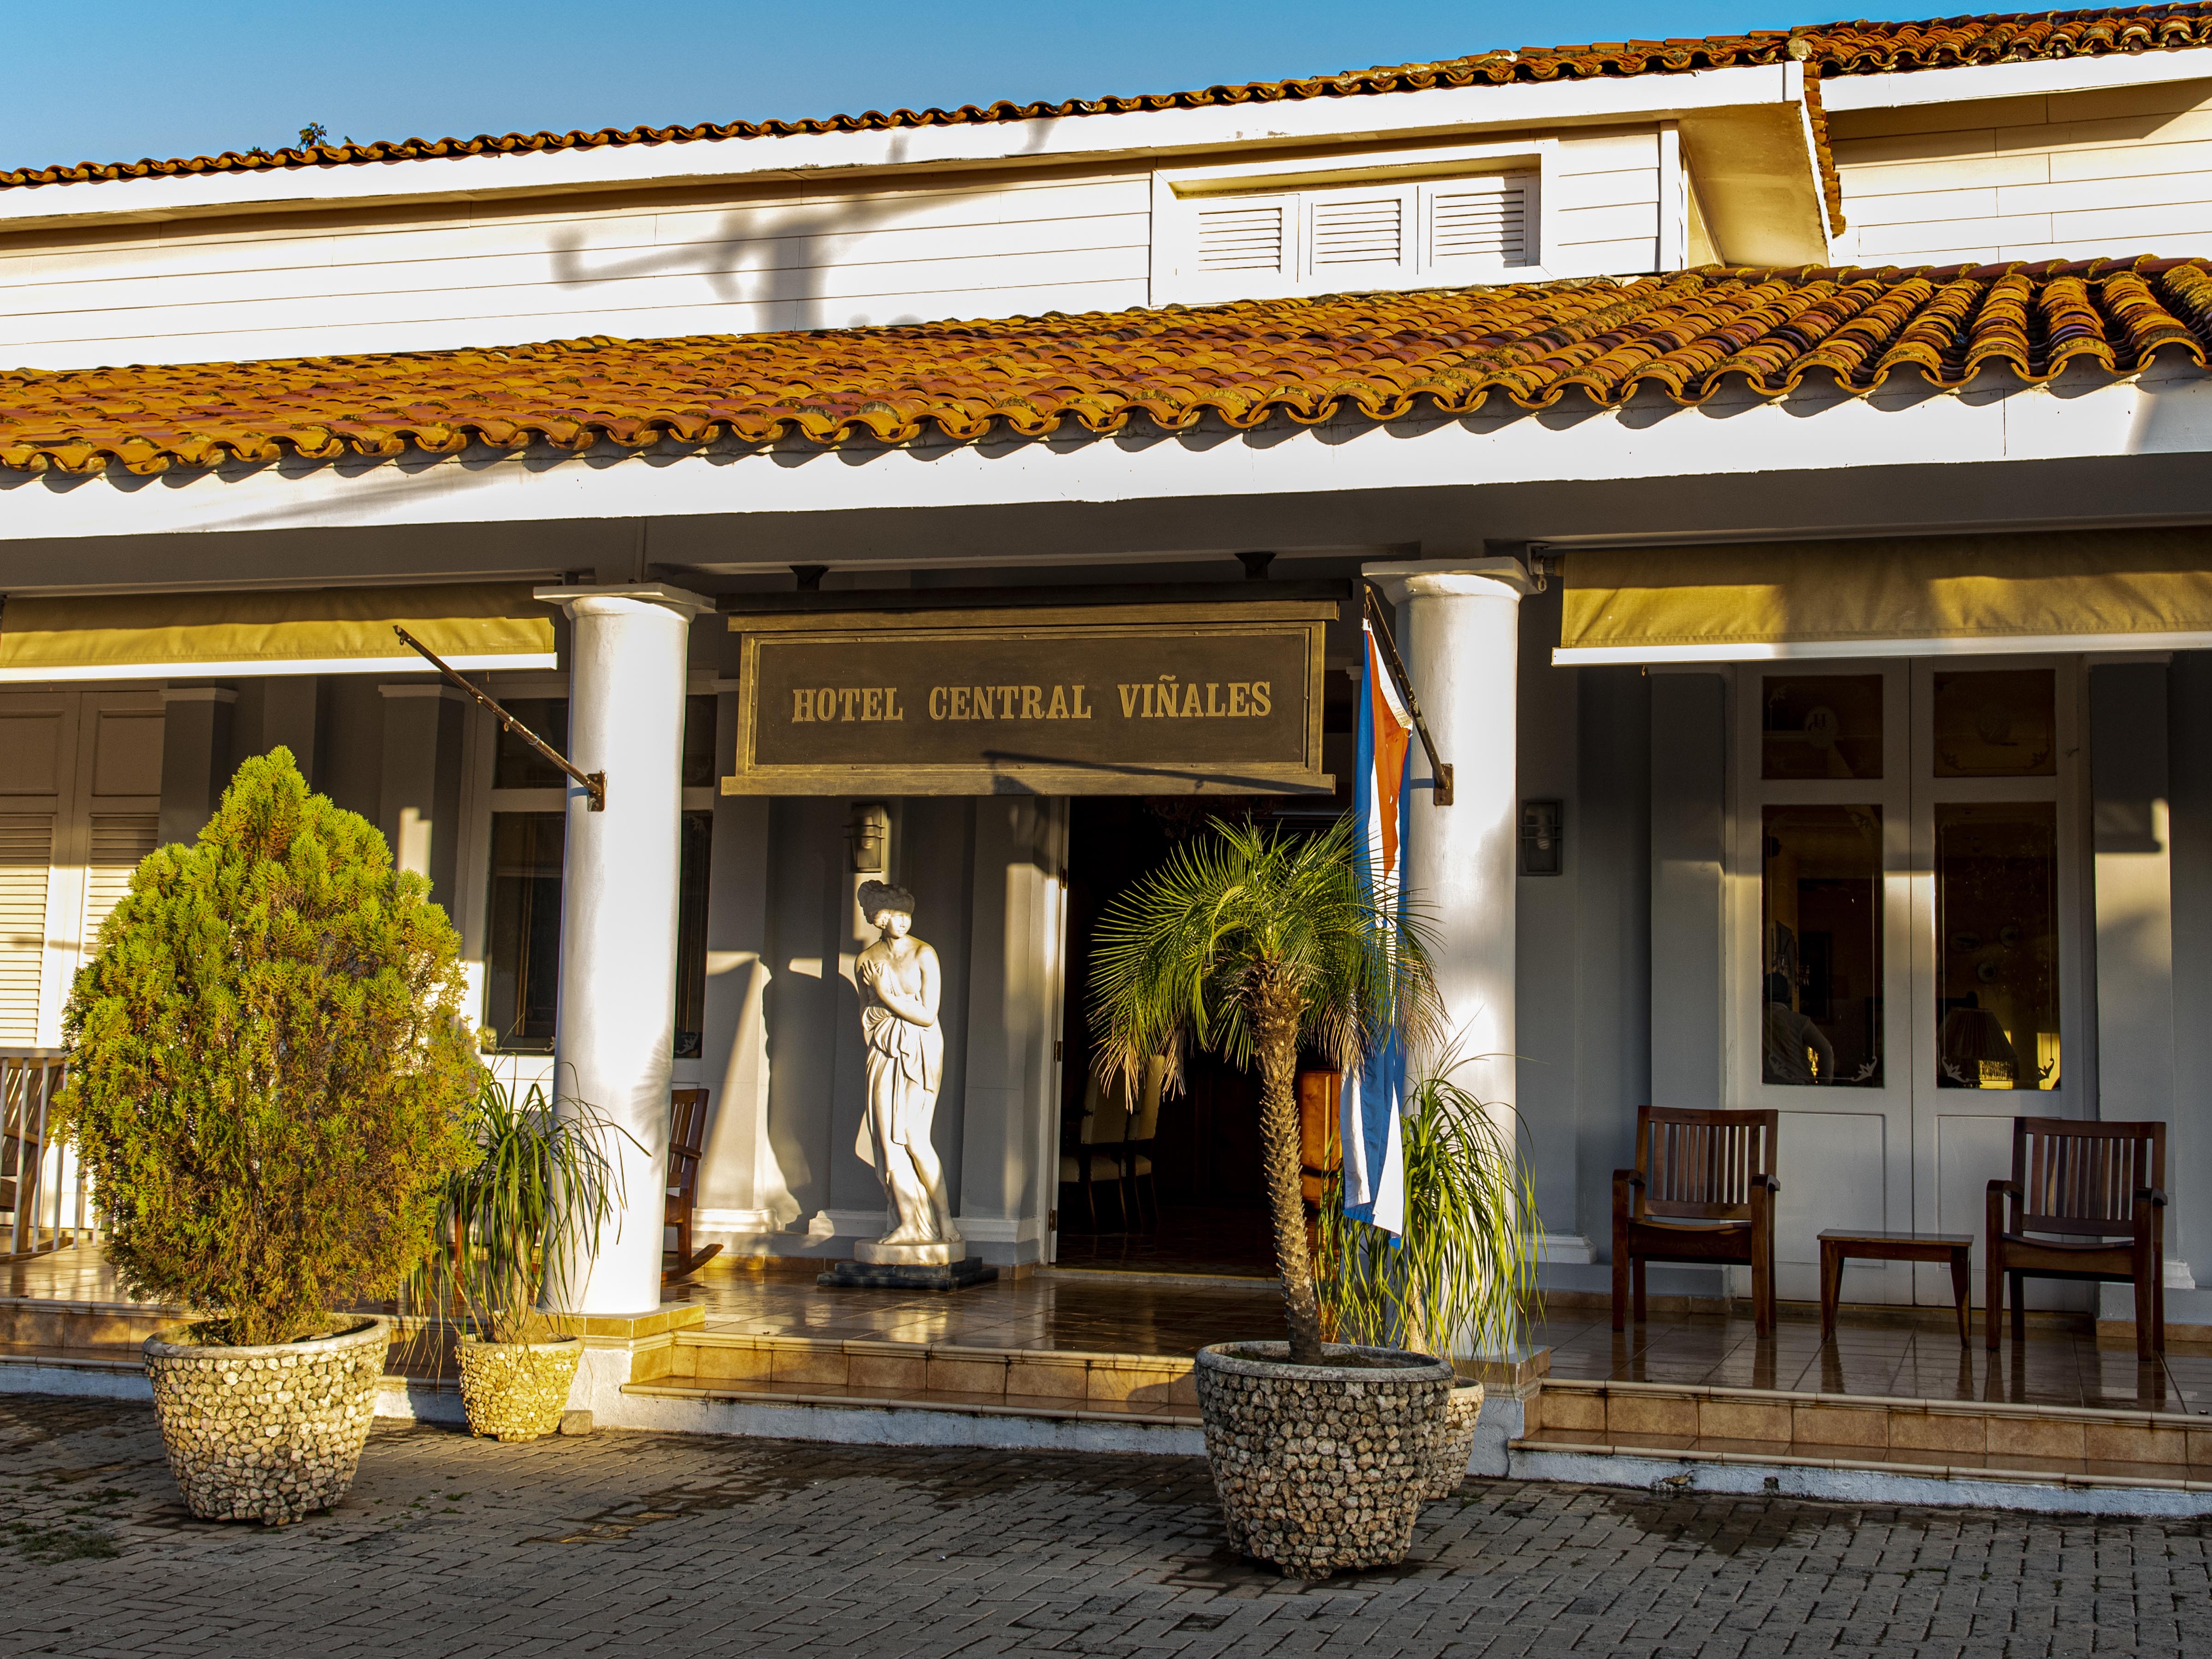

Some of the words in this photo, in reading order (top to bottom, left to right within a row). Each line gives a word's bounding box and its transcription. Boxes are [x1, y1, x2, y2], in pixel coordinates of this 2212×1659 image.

[792, 687, 903, 723] HOTEL
[929, 685, 1091, 720] CENTRAL
[1117, 674, 1271, 718] VIÑALES
